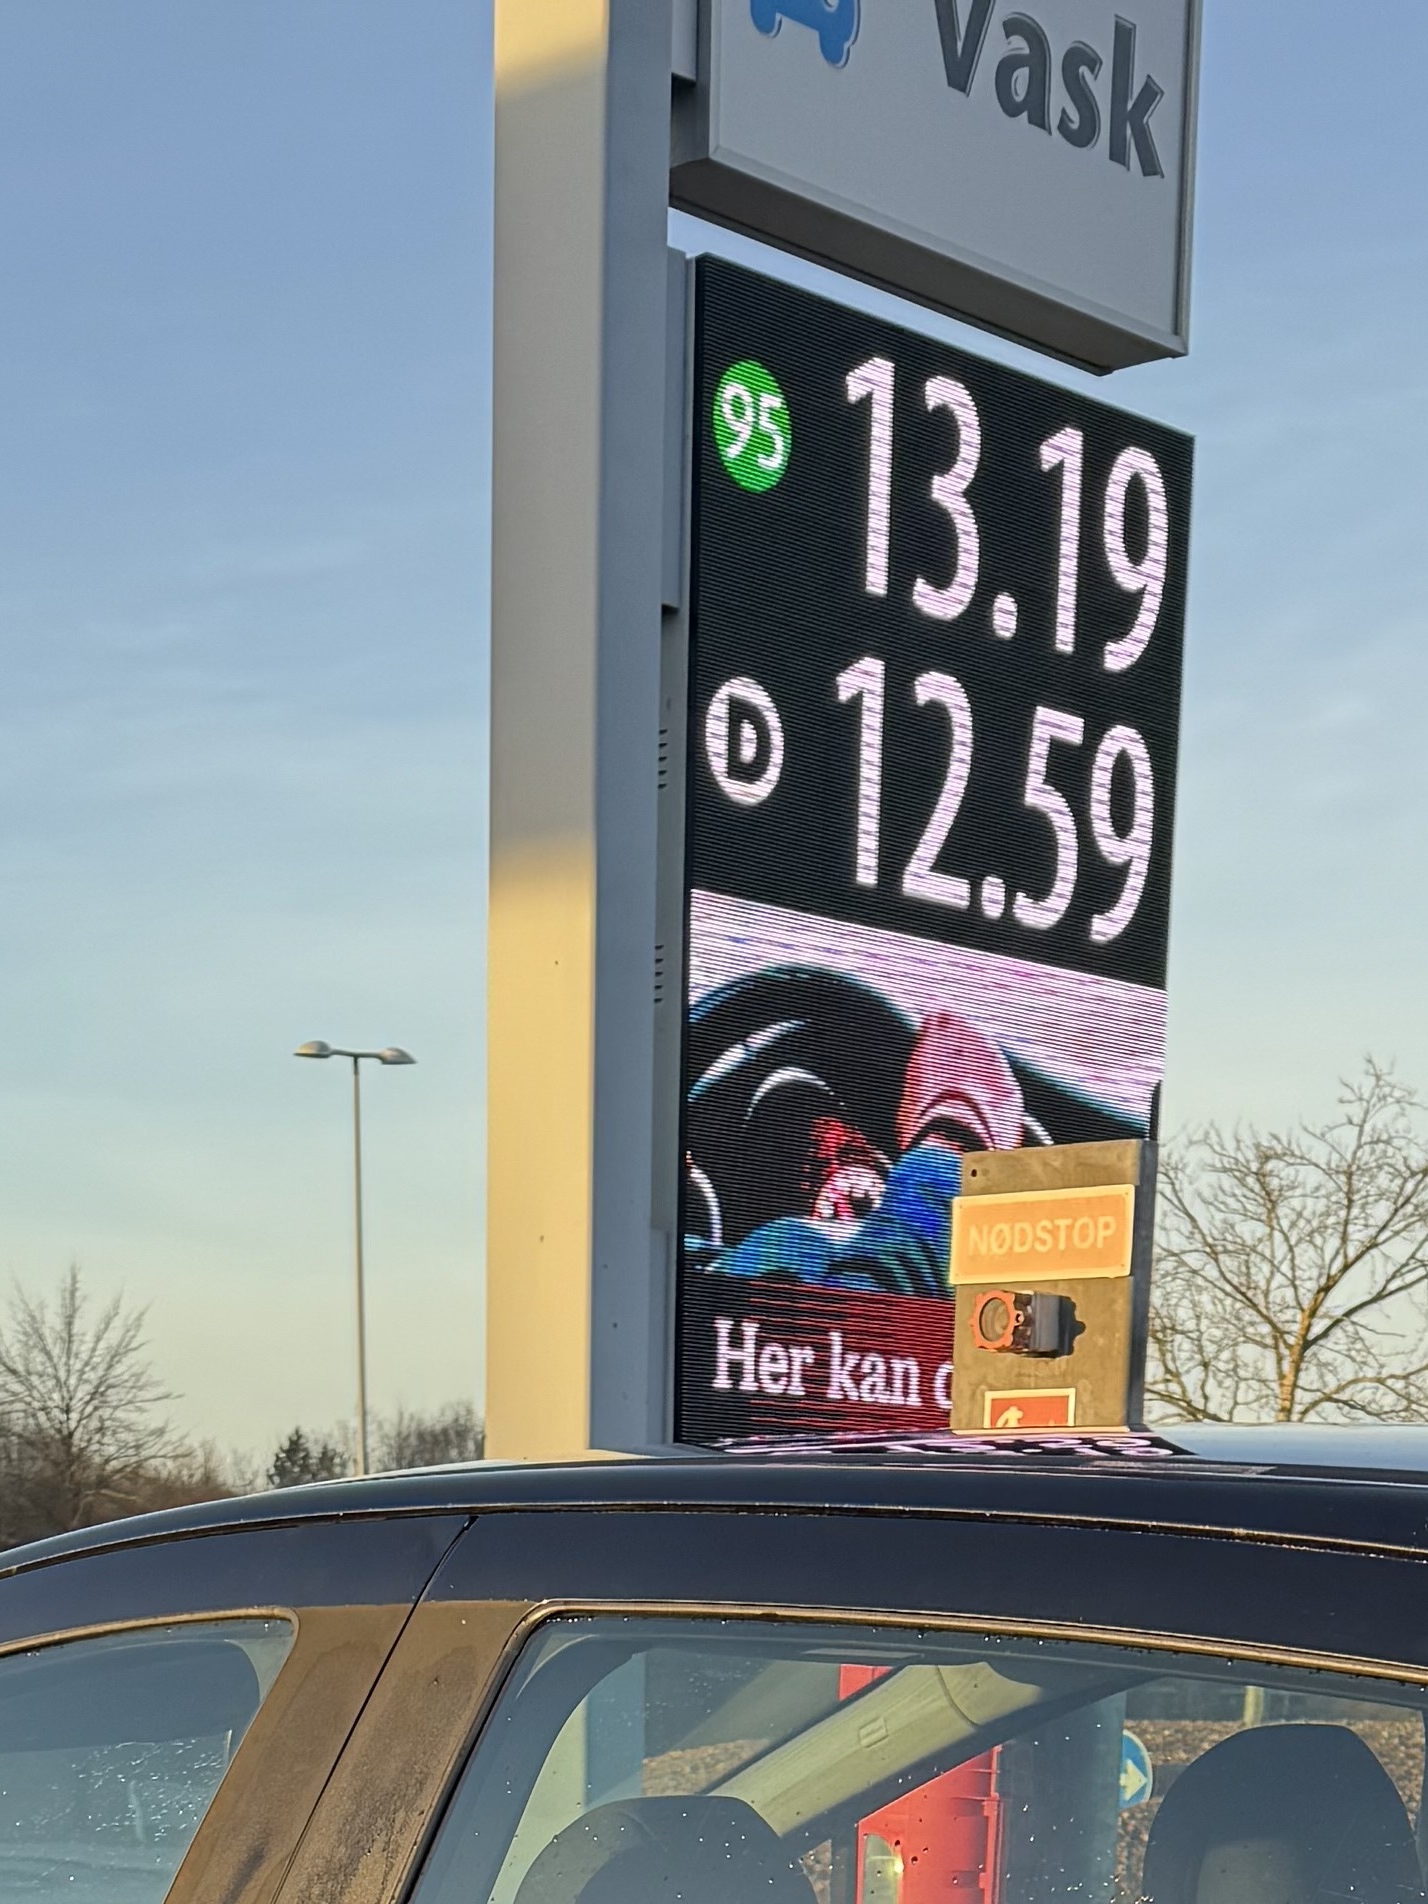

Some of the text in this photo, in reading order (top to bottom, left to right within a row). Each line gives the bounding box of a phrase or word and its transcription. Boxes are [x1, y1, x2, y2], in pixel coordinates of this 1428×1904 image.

[934, 0, 1164, 179] Vask
[720, 357, 1169, 673] 95 13.19
[835, 656, 1155, 943] 12.59
[968, 1215, 1117, 1257] NØDSTOP
[712, 1316, 815, 1397] Her
[826, 1331, 922, 1406] kan
